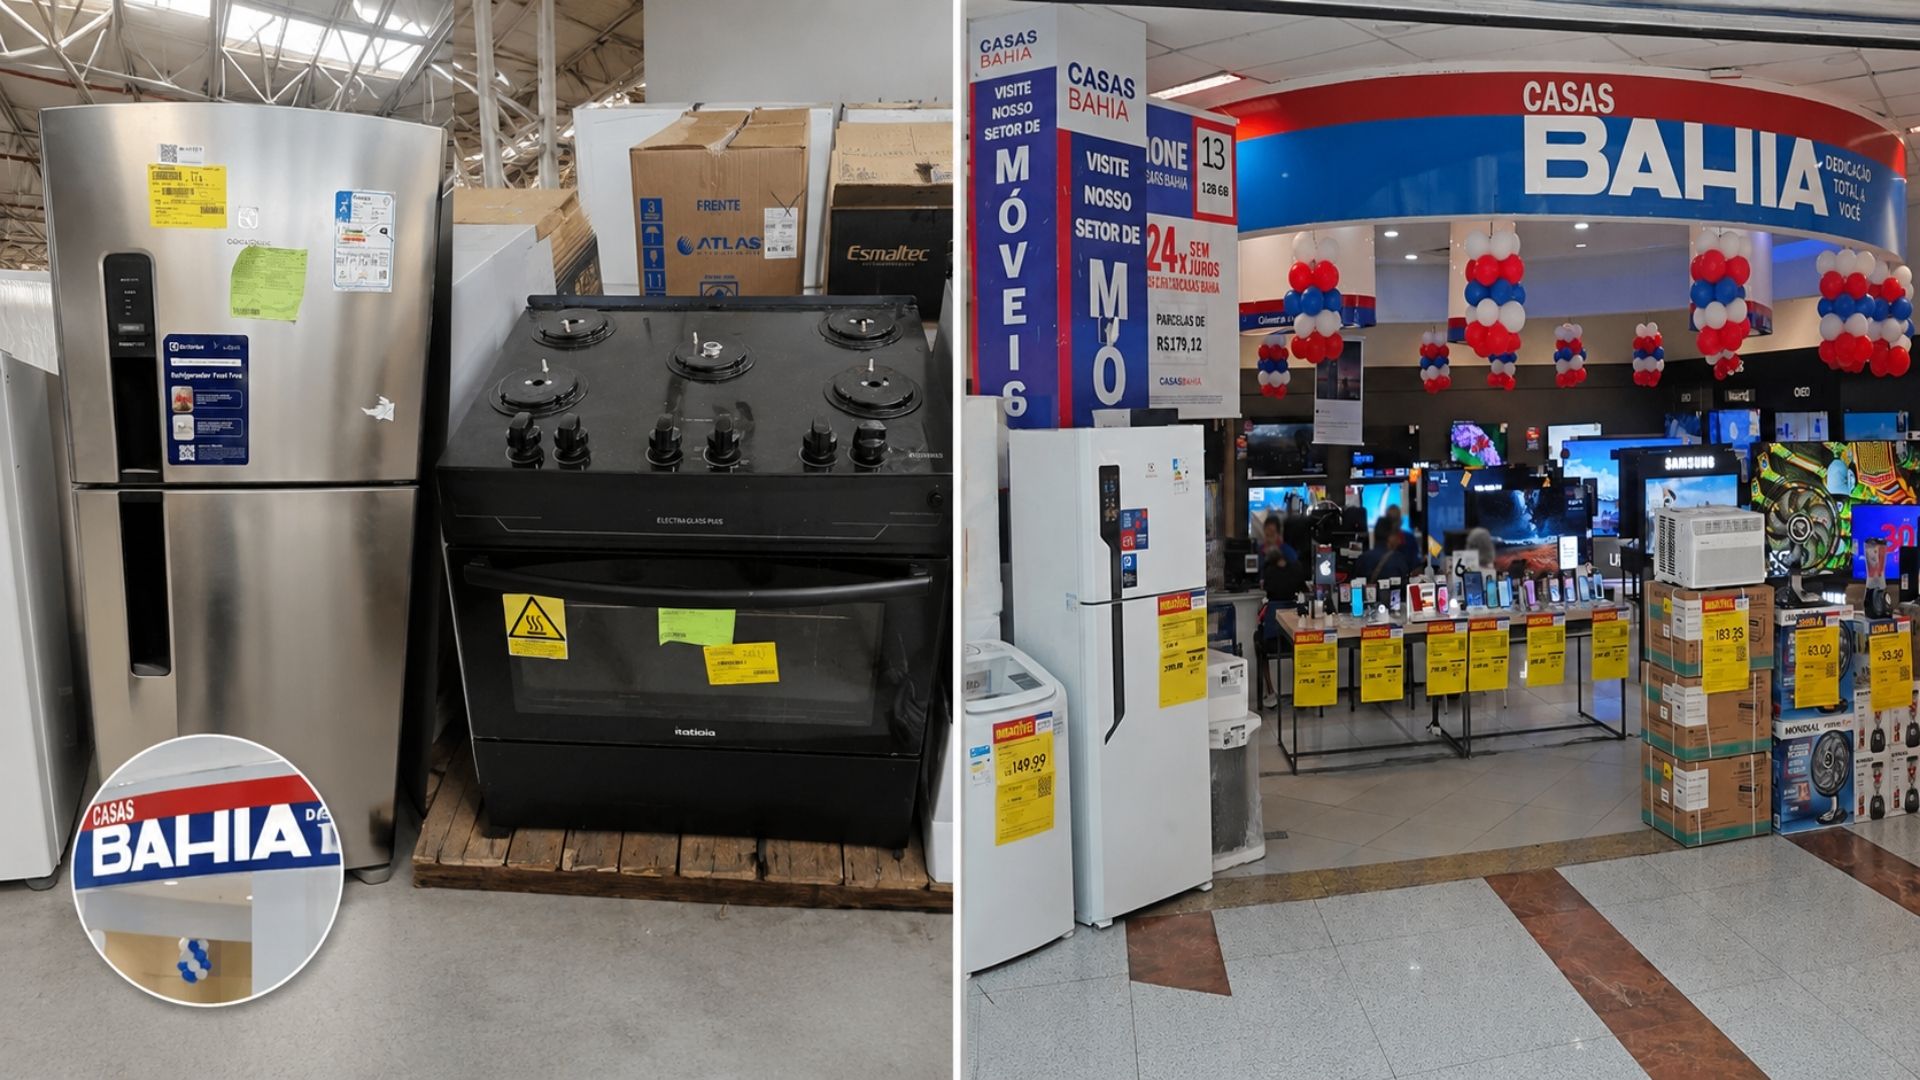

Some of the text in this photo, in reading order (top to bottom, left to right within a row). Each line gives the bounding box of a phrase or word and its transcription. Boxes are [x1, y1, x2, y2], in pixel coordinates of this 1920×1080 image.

[980, 29, 1038, 53] CASAS
[980, 46, 1032, 69] BAHIA
[995, 80, 1032, 99] VISITE
[1067, 61, 1136, 100] CASAS
[1069, 88, 1129, 123] BAHIA
[1523, 80, 1615, 114] CASAS
[992, 101, 1033, 120] NOSSO
[984, 118, 1041, 141] SETOR DE
[1086, 150, 1130, 179] VISITE
[1202, 136, 1226, 171] 13
[1524, 114, 1829, 217] BAHIA
[1084, 186, 1132, 212] NOSSO
[1202, 182, 1217, 195] 128
[1833, 178, 1859, 200] TOTAL
[647, 201, 656, 213] 3
[697, 200, 740, 211] FRENTE
[1075, 218, 1141, 245] SETOR DE
[697, 236, 762, 250] ATLAS
[847, 245, 930, 262] Esmaltec
[1190, 241, 1210, 258] SEM
[1189, 259, 1220, 278] JUROS
[1195, 315, 1206, 327] DE
[1156, 336, 1202, 354] R$179,12
[1665, 455, 1716, 471] SAMSUNG
[1785, 723, 1820, 735] MONDIAL
[93, 799, 135, 826] CASAS
[92, 803, 312, 877] BAHIA
